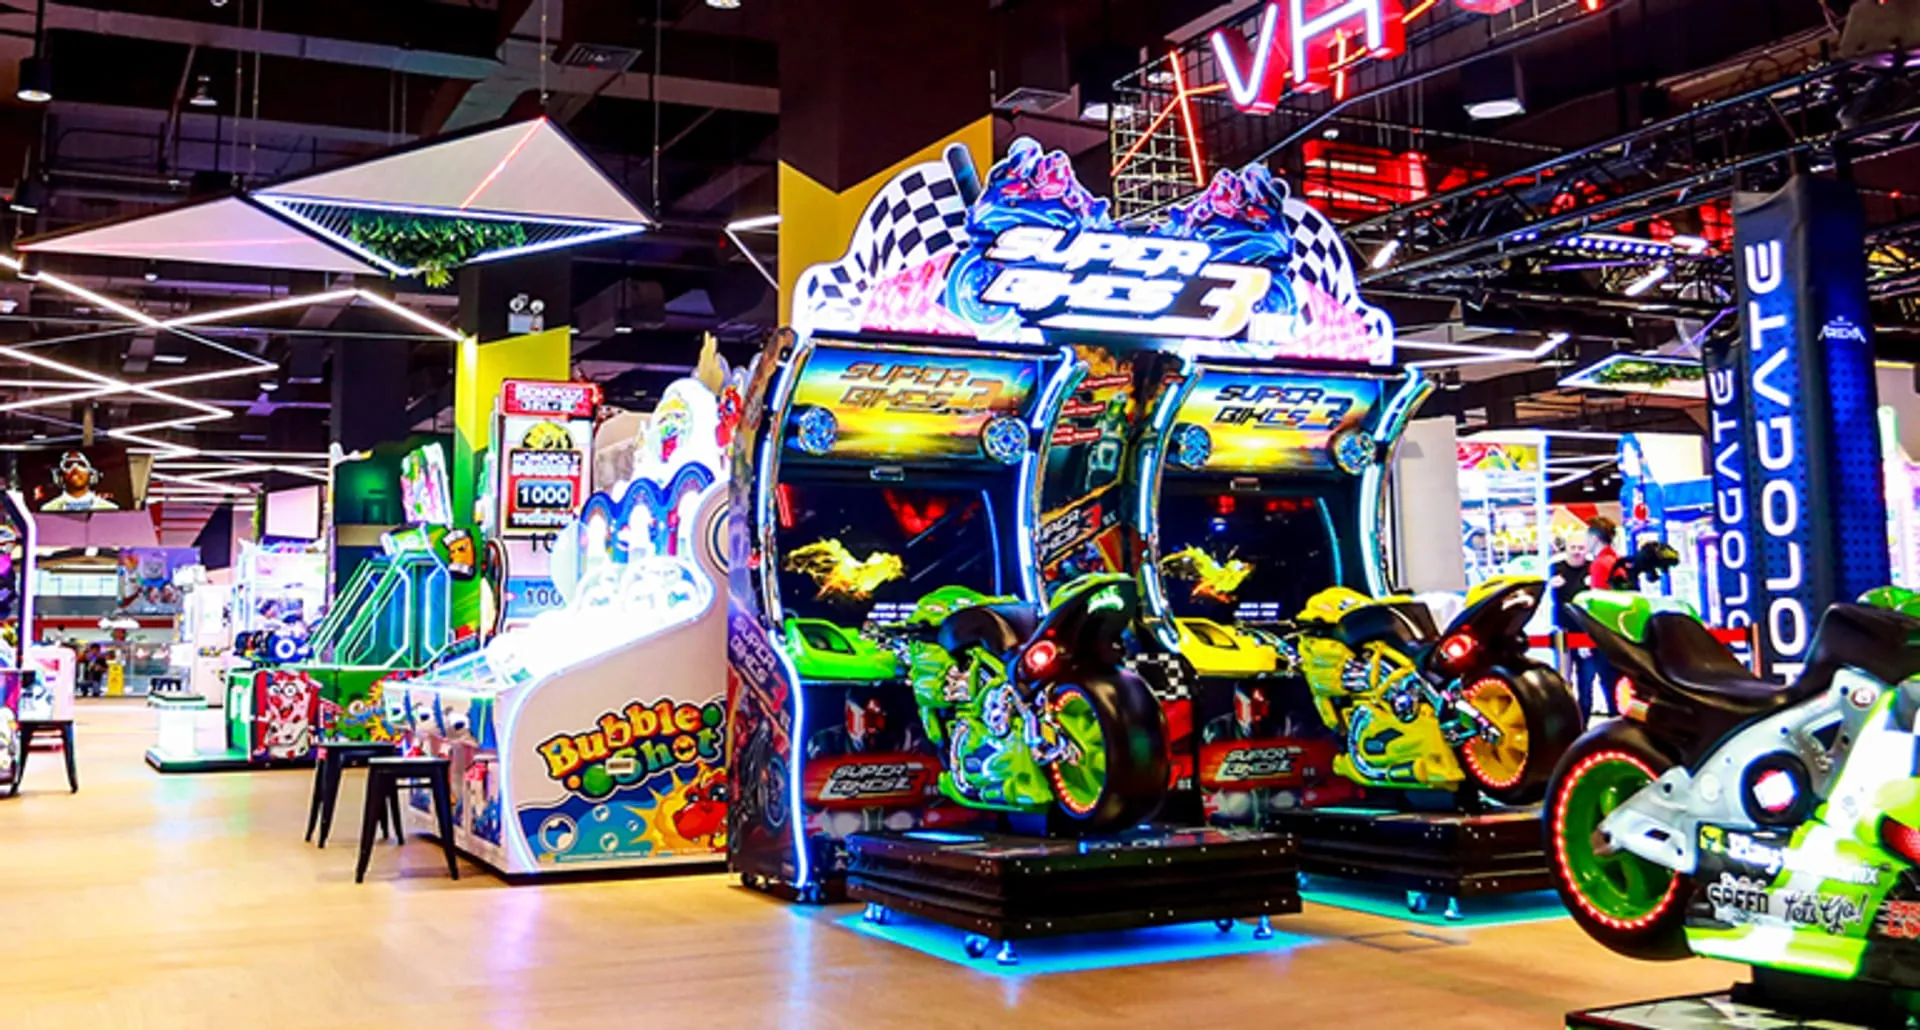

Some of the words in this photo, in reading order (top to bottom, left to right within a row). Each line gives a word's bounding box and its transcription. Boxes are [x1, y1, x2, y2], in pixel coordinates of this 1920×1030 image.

[983, 224, 1212, 278] SUPER
[1196, 261, 1272, 338] 3
[839, 360, 971, 388] SUPER
[839, 385, 955, 410] BIKES
[967, 377, 1005, 412] 3
[1214, 384, 1326, 405] SUPER
[1213, 404, 1312, 427] BIKES
[1322, 396, 1355, 431] 3
[519, 486, 570, 505] 1000
[1081, 504, 1102, 537] 3
[540, 699, 700, 778] Bubble
[612, 726, 720, 784] Shot
